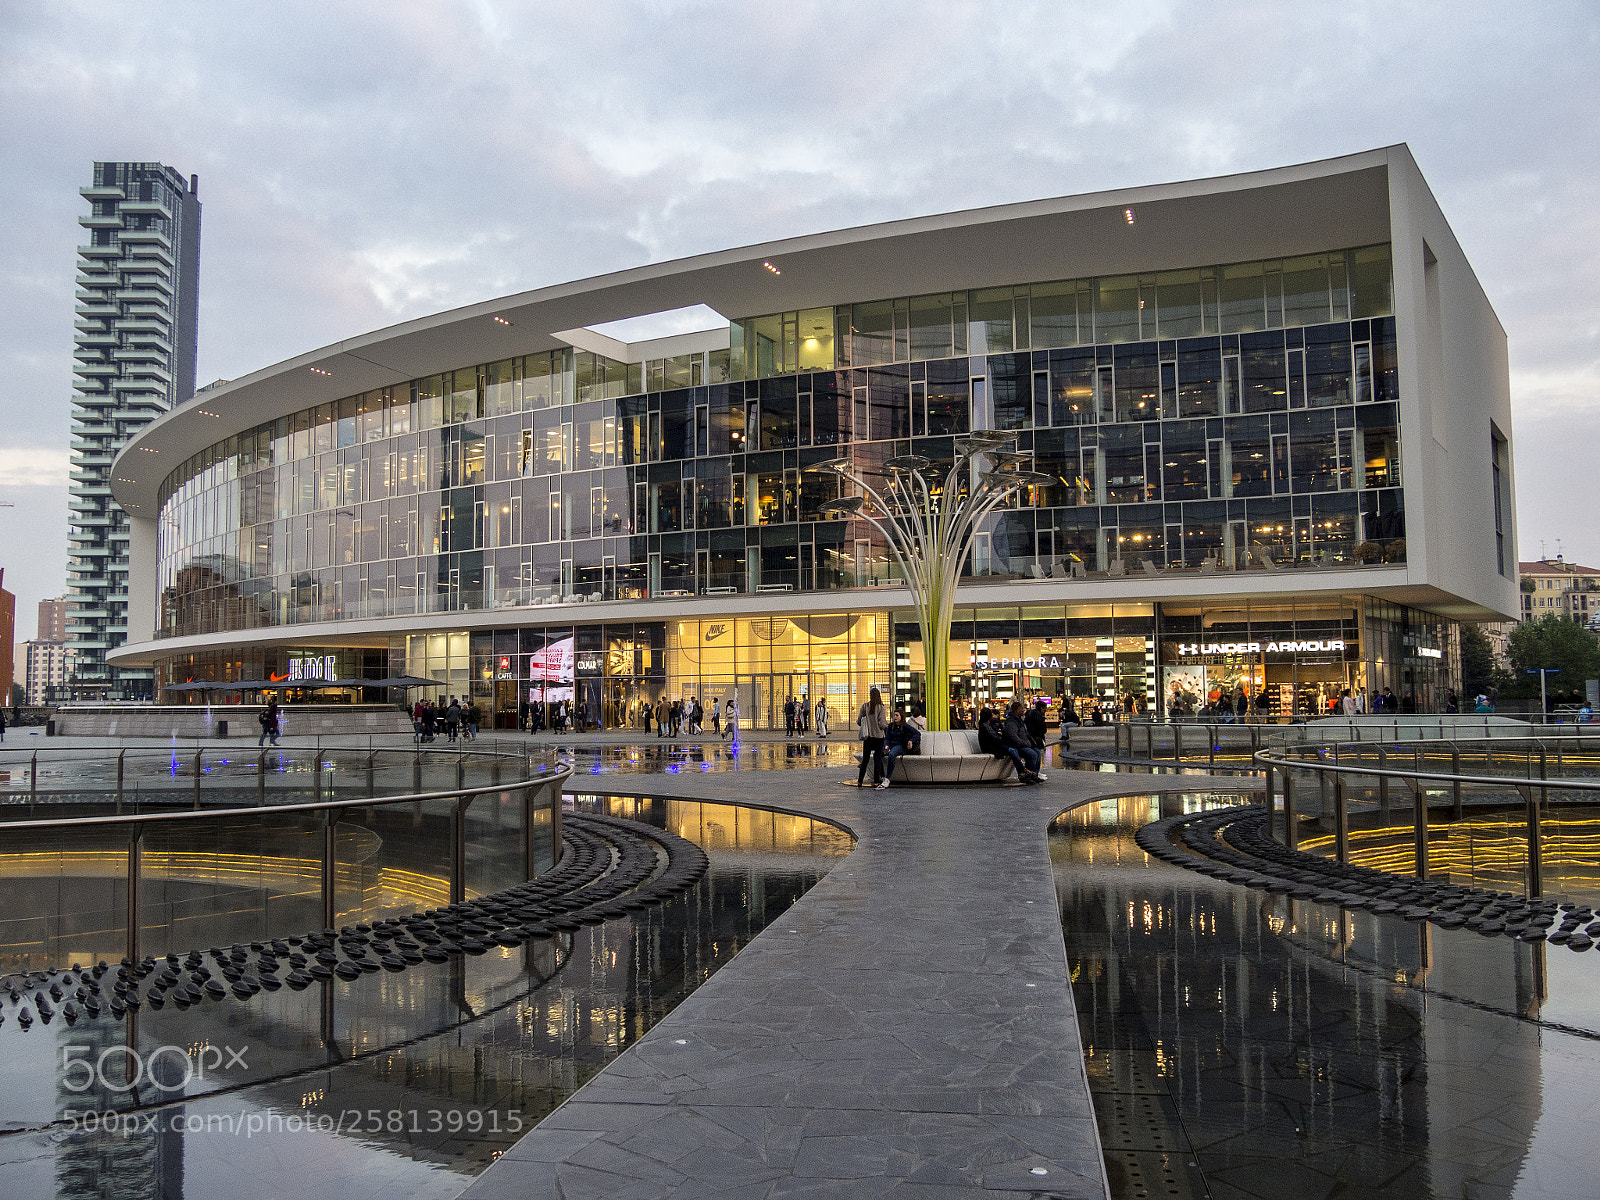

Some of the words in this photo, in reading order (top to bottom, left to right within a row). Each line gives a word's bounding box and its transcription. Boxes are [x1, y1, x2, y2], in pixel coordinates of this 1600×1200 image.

[709, 624, 725, 634] NIKE
[1201, 642, 1260, 654] UNDER
[1266, 640, 1345, 652] ARMOUR
[287, 658, 309, 681] JUST
[309, 657, 323, 679] DO
[577, 660, 597, 670] COLMAR
[980, 656, 1060, 669] SEPHORA
